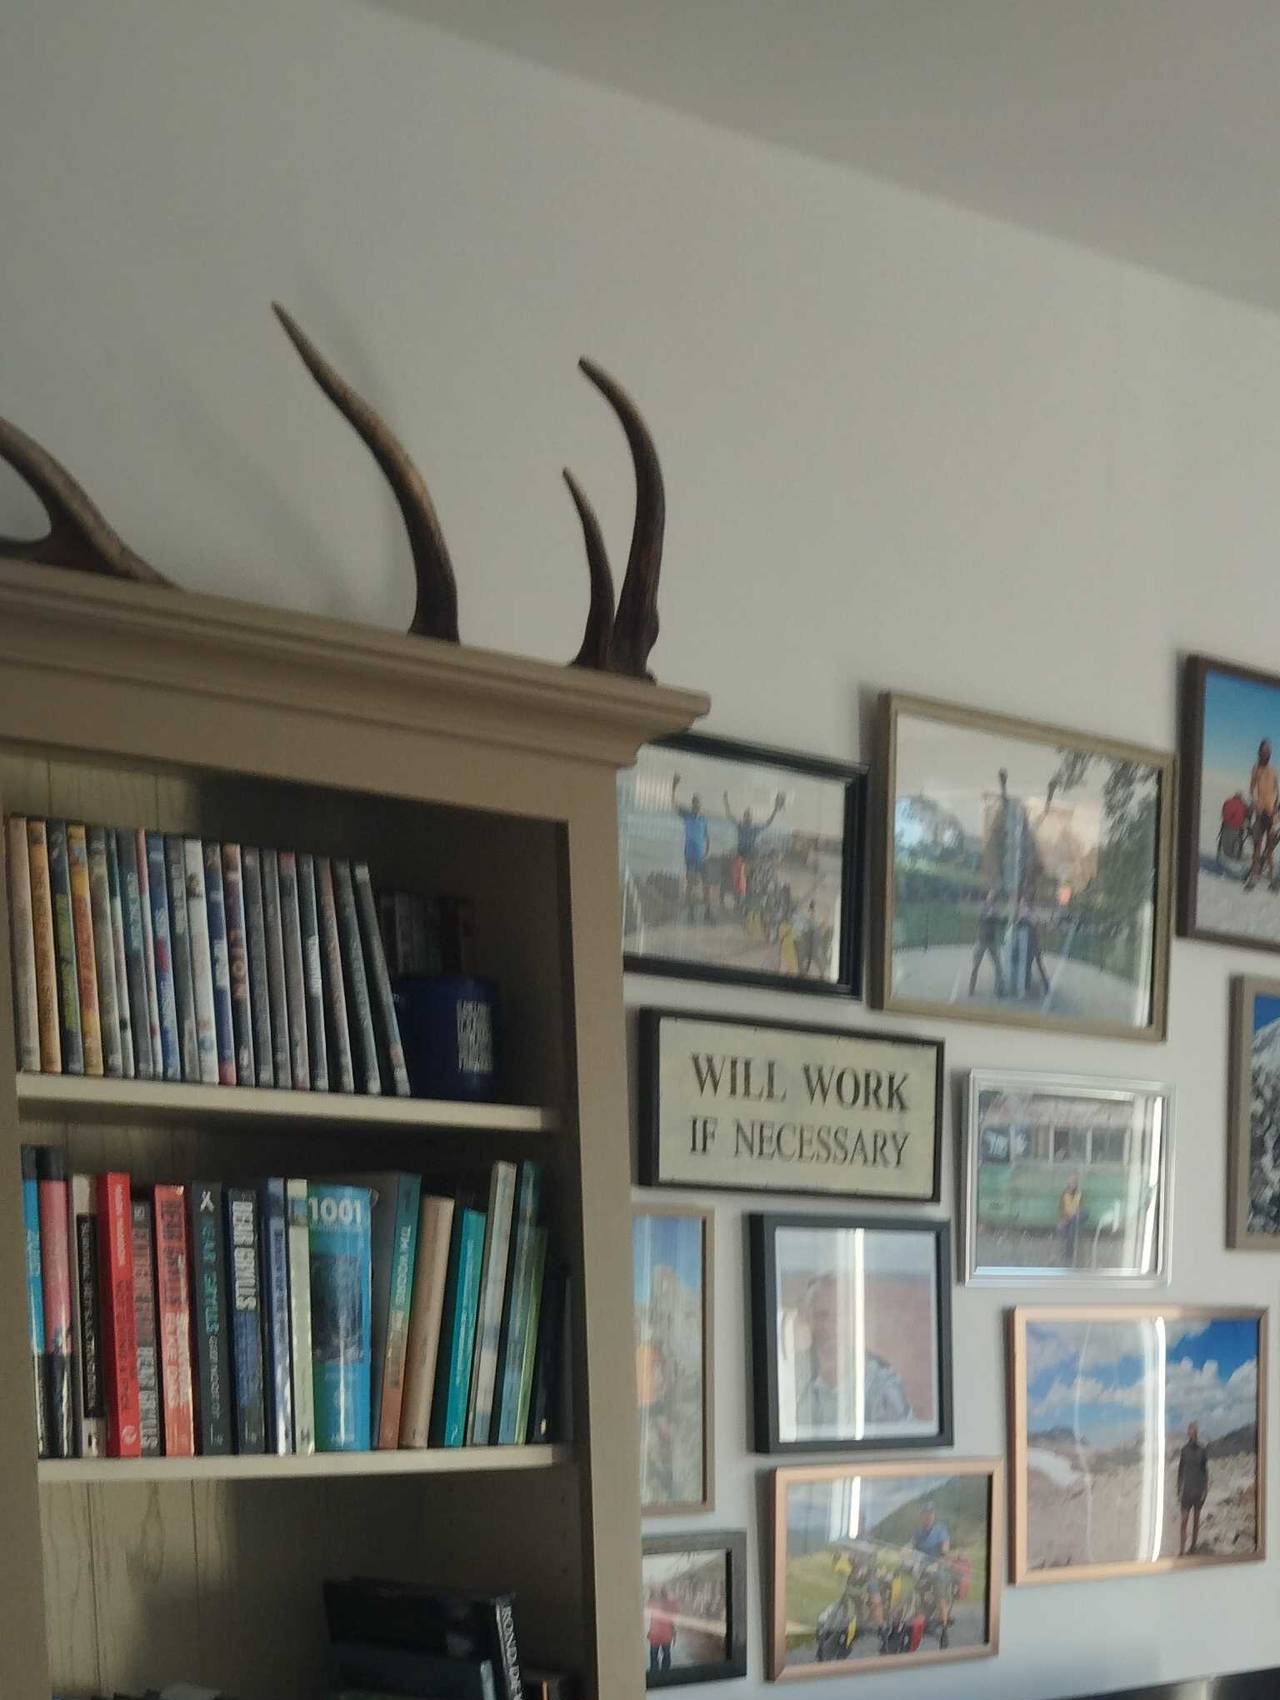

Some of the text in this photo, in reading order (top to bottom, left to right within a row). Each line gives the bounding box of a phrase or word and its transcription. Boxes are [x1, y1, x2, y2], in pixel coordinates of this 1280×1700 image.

[690, 1053, 911, 1112] WILL WORK
[689, 1115, 911, 1170] IF NECESSARY
[308, 1196, 362, 1226] 1001
[232, 1247, 257, 1311] GRYLLS
